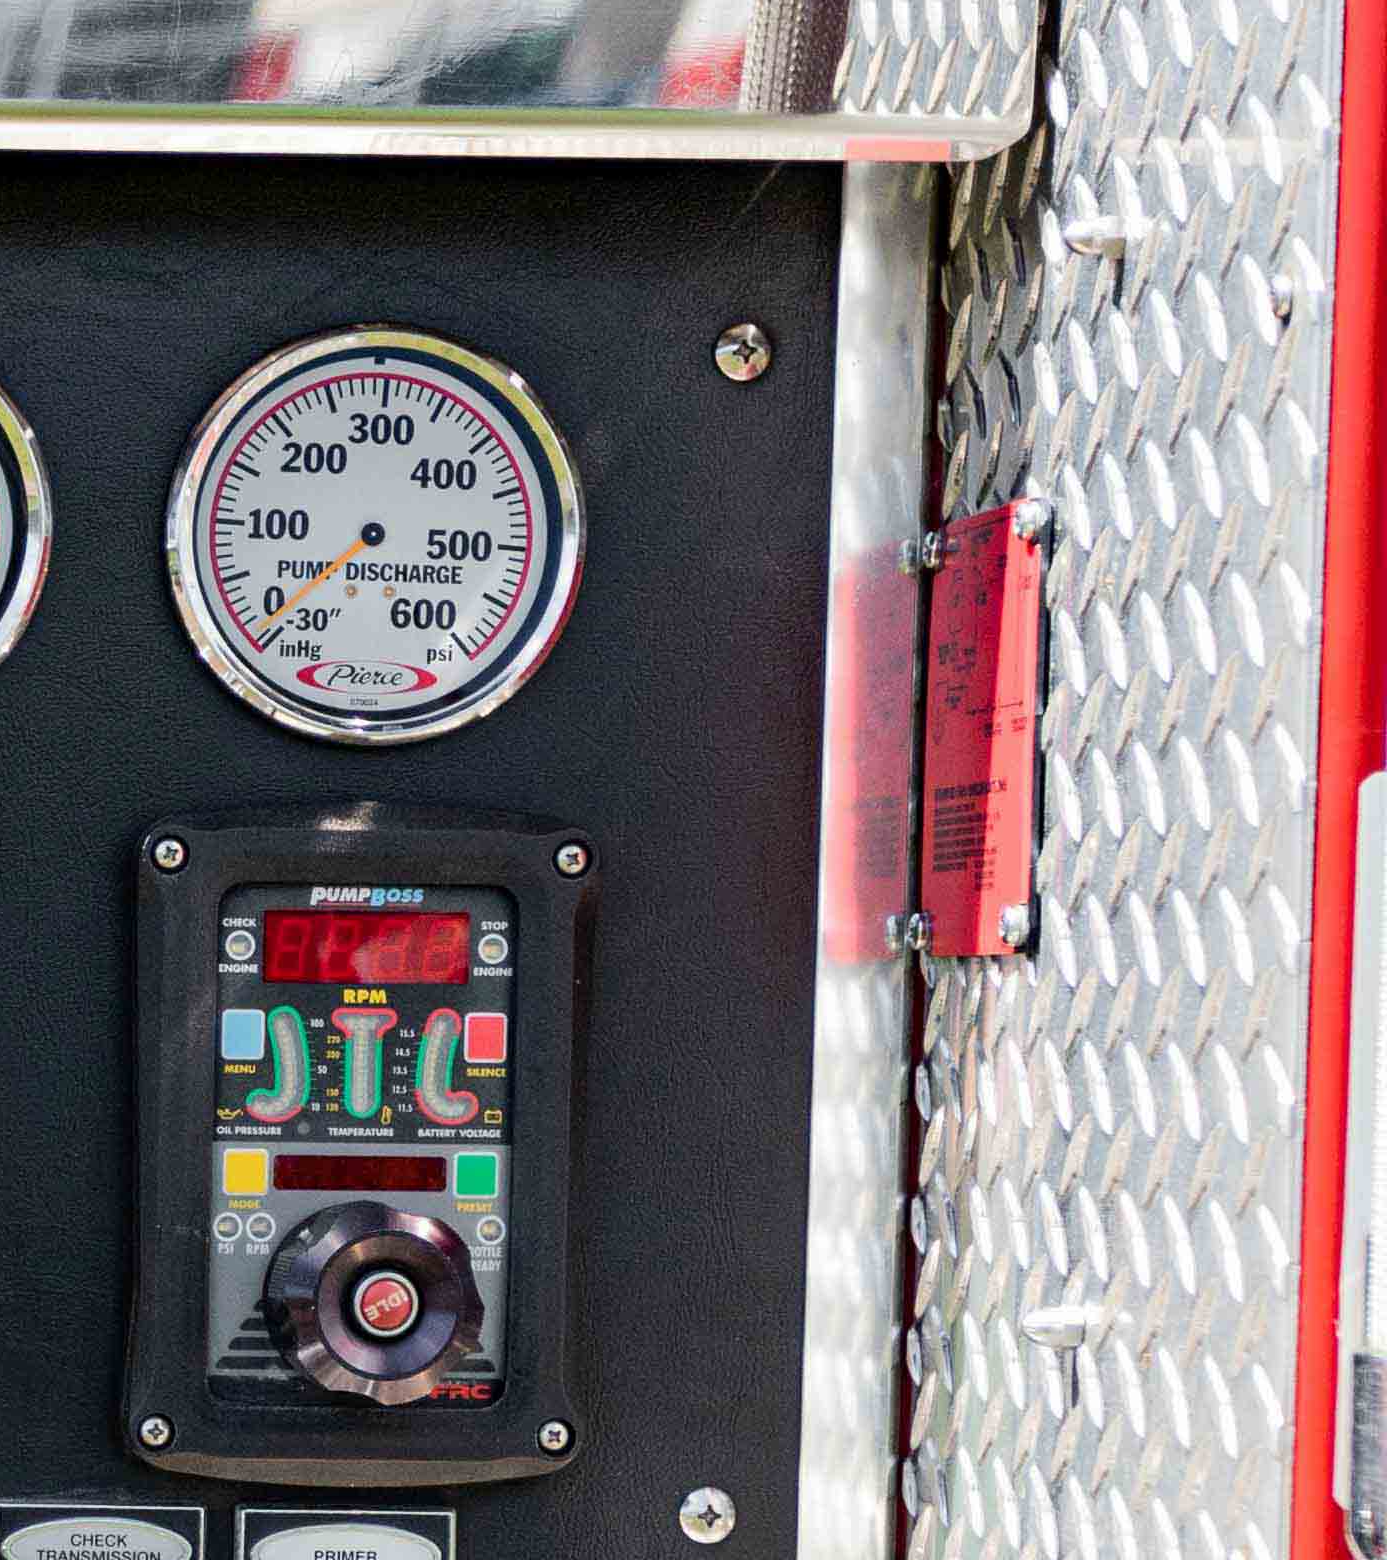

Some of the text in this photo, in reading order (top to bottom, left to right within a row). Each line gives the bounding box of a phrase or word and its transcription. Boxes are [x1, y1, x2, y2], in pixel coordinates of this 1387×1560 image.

[348, 413, 415, 445] 300
[281, 443, 347, 474] 200
[410, 458, 477, 490] 400
[248, 509, 309, 540] 100
[426, 530, 492, 561] 500
[345, 562, 462, 584] DISCHARGE
[390, 598, 456, 630] 600
[310, 886, 424, 906] PUMPBOSS
[222, 918, 257, 927] CHECK
[481, 921, 508, 931] STOP
[219, 963, 259, 973] ENGINE
[473, 967, 513, 977] ENGINE
[343, 989, 387, 1004] RPM
[224, 1065, 256, 1074] MENU
[466, 1068, 507, 1077] SILENCE
[216, 1126, 282, 1135] OIL PRESSURE
[328, 1127, 394, 1137] TEMPERATURE
[418, 1128, 501, 1138] BATTERY VOLTAGE
[71, 1534, 127, 1547] CHECK
